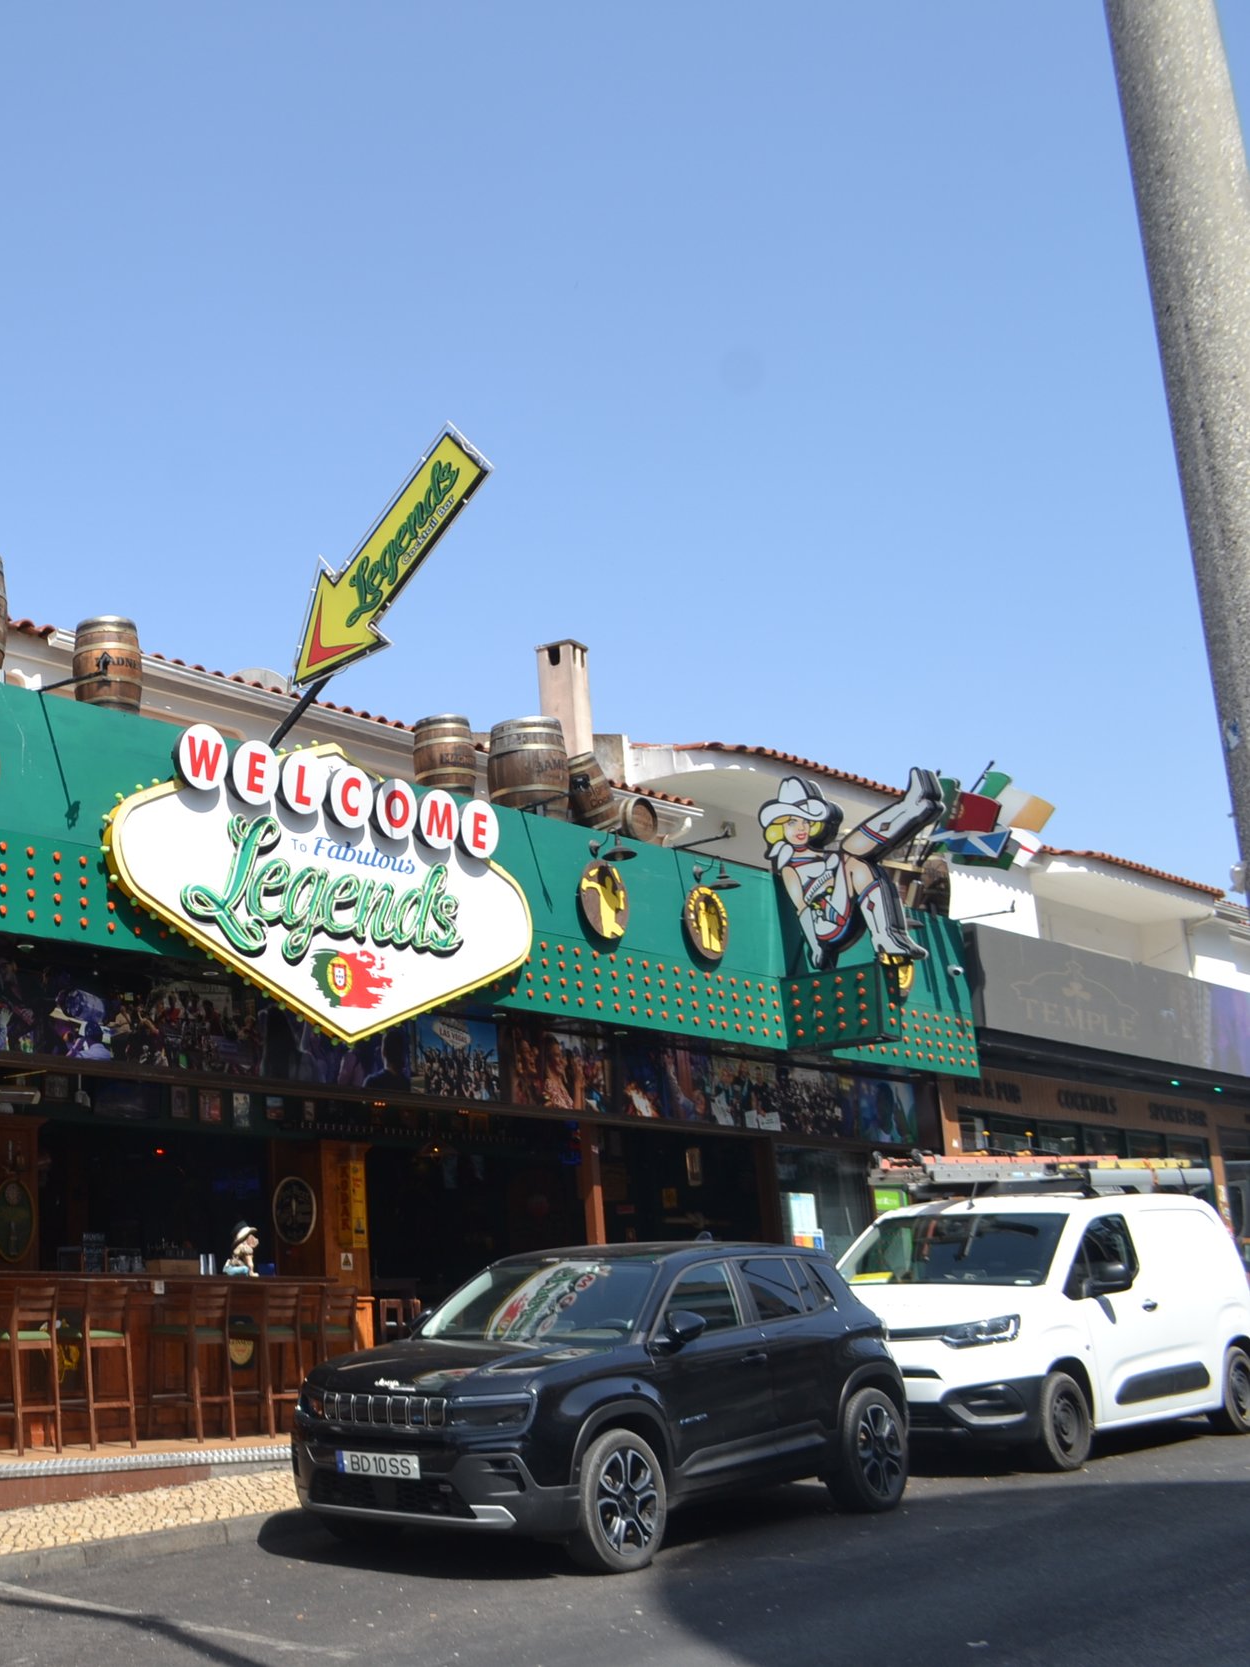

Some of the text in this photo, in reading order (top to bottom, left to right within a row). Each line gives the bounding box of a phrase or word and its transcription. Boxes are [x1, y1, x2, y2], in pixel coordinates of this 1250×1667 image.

[346, 460, 459, 628] Legends
[401, 494, 456, 566] Cocktail Bar
[187, 735, 488, 850] WELCOME
[180, 813, 466, 968] Legends
[313, 836, 416, 876] Fabulous
[1021, 997, 1139, 1041] TEMPLE
[1057, 1088, 1117, 1115] COCKTAILS
